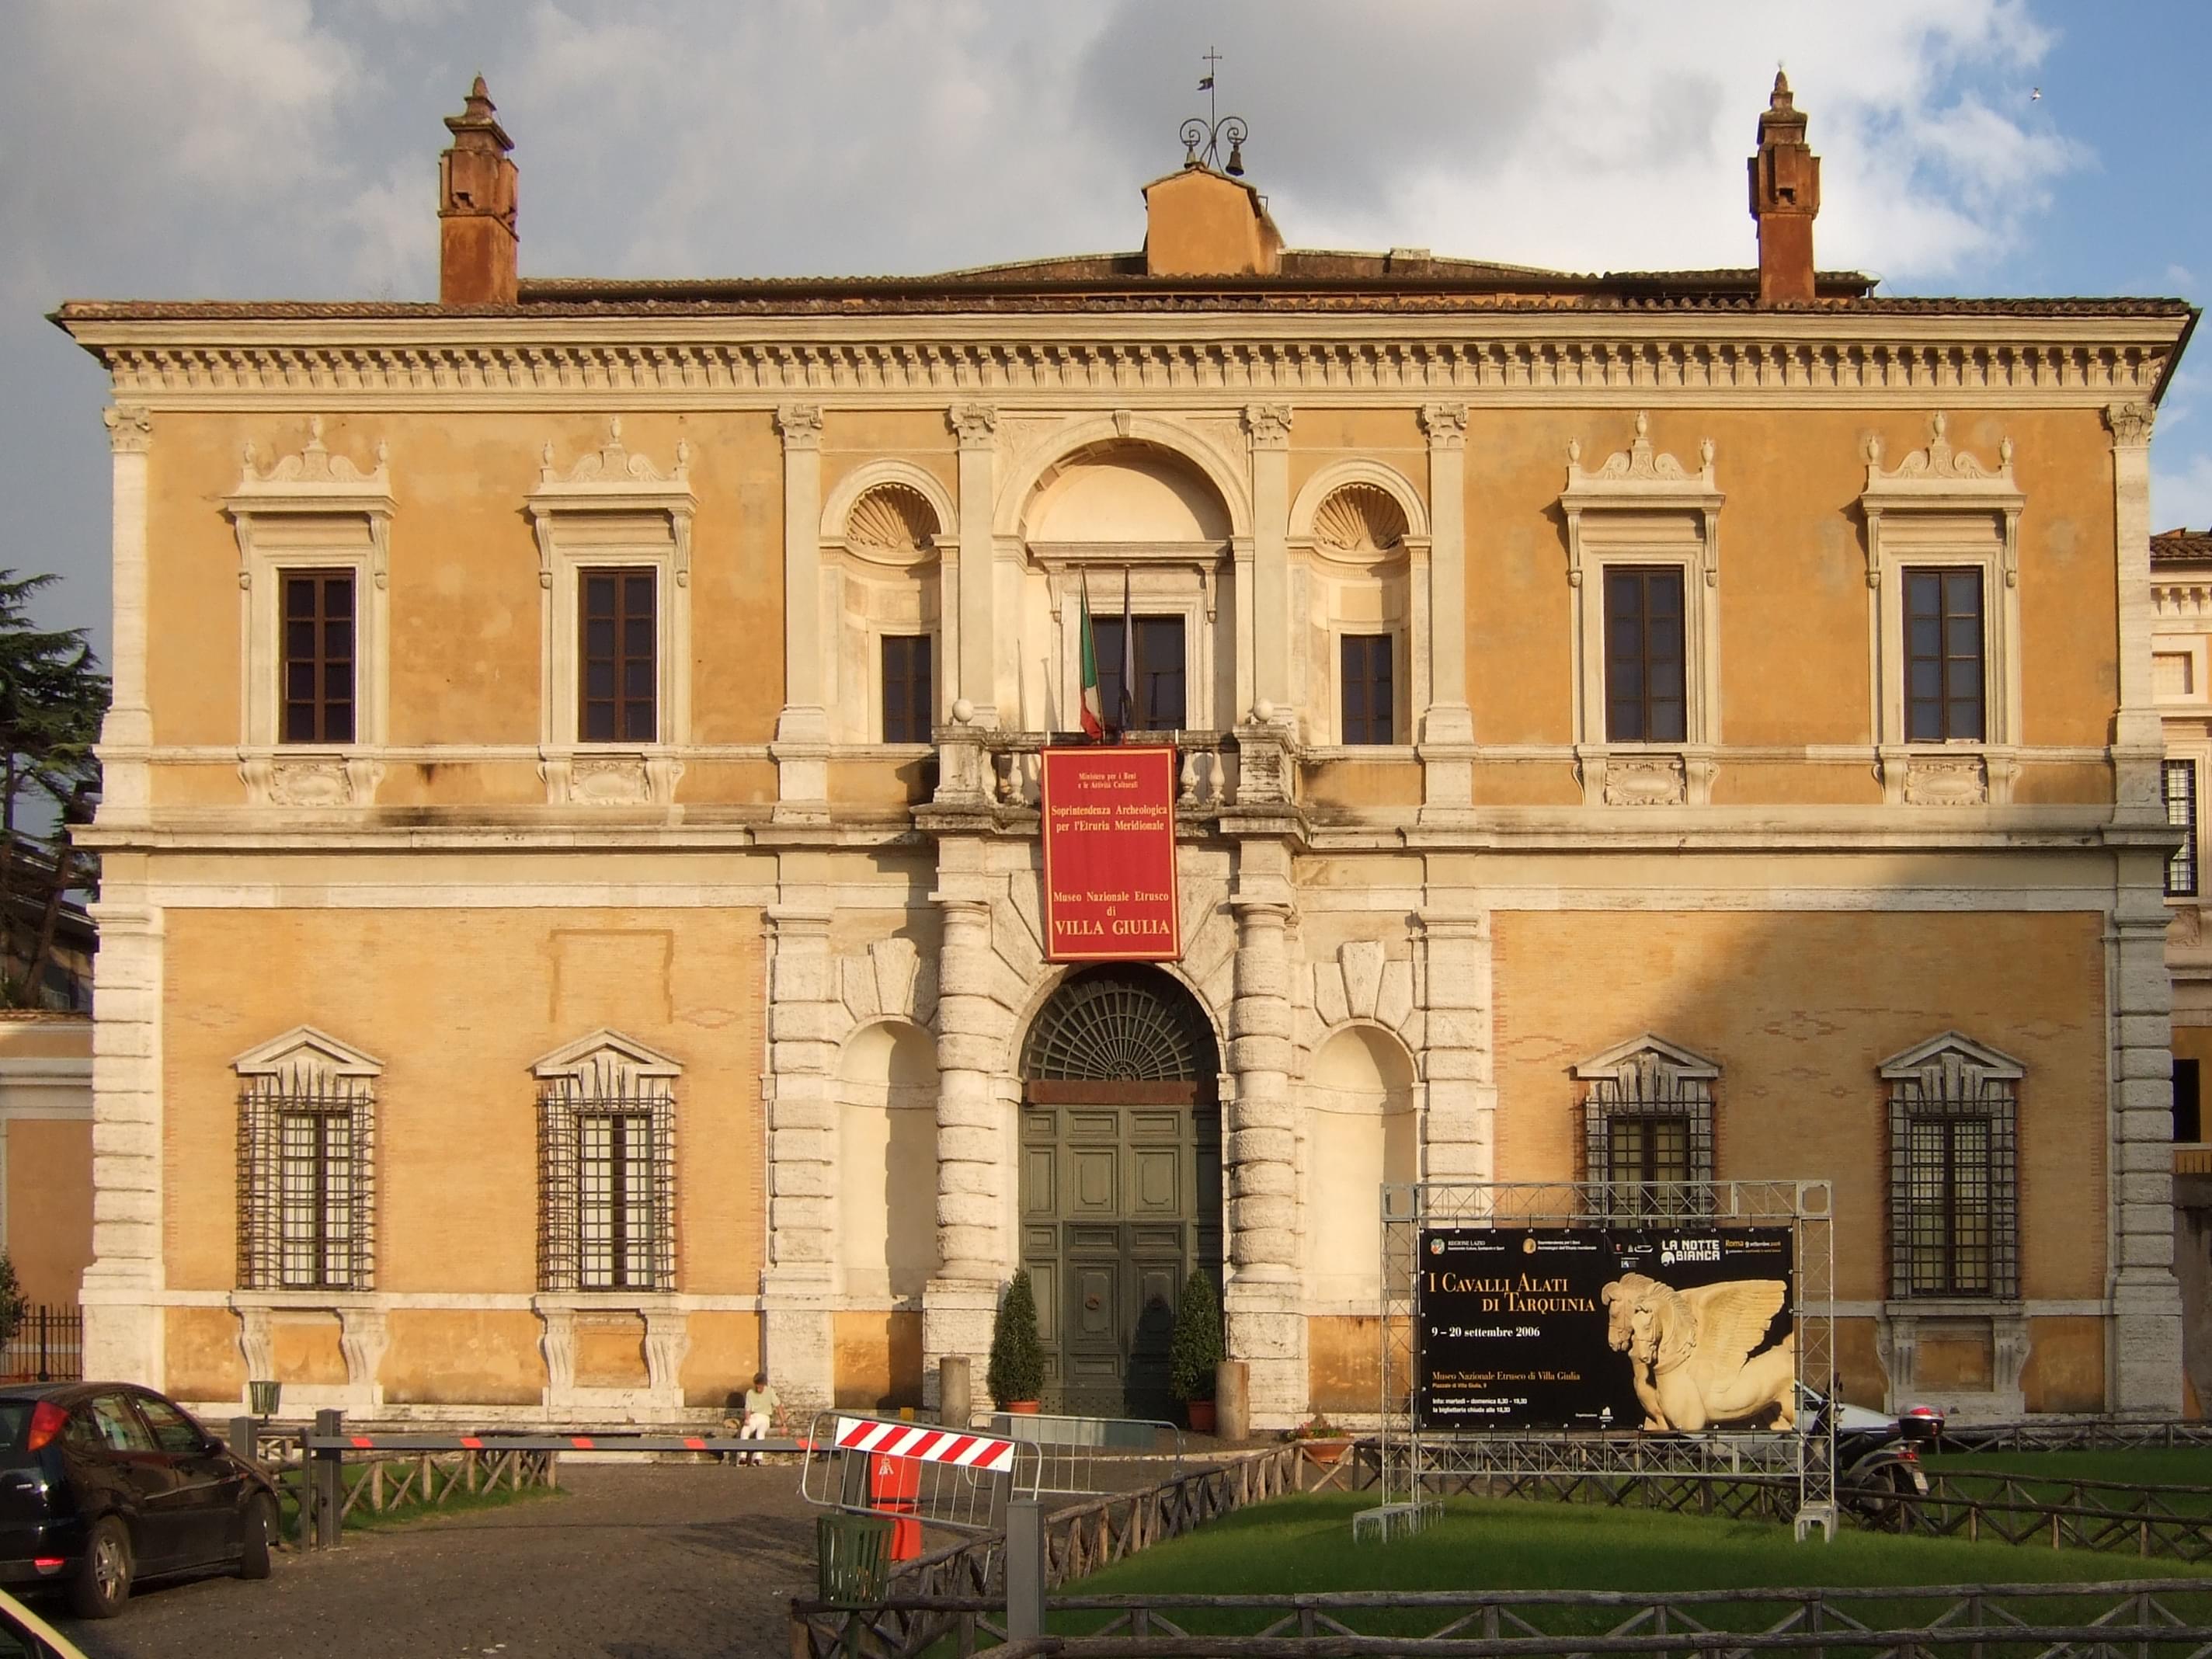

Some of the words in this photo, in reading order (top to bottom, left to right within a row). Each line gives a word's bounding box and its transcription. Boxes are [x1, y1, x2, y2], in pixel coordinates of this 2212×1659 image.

[1114, 781, 1138, 789] Culturali
[1052, 805, 1111, 817] Soprintendenza
[1116, 805, 1167, 816] Archeologica
[1056, 823, 1069, 833] per
[1075, 822, 1109, 831] l'Etruria
[1115, 820, 1164, 830] Meridionale
[1054, 892, 1081, 902] Museo
[1087, 892, 1129, 901] Nazionale
[1136, 892, 1168, 901] Etrusco
[1107, 906, 1116, 916] di
[1056, 921, 1104, 935] VILLA
[1112, 920, 1170, 935] GIULIA
[1662, 1240, 1678, 1250] LA
[1682, 1240, 1720, 1250] NOTTE
[1676, 1251, 1720, 1261] BIANCA
[1430, 1273, 1437, 1292] I
[1431, 1327, 1438, 1337] 9
[1449, 1327, 1461, 1337] 20
[1464, 1327, 1513, 1337] settembre
[1516, 1327, 1540, 1337] 2006
[1497, 1372, 1525, 1380] Etrusco
[1528, 1372, 1536, 1380] di
[1538, 1372, 1555, 1380] Villa
[1557, 1372, 1580, 1380] Giulia
